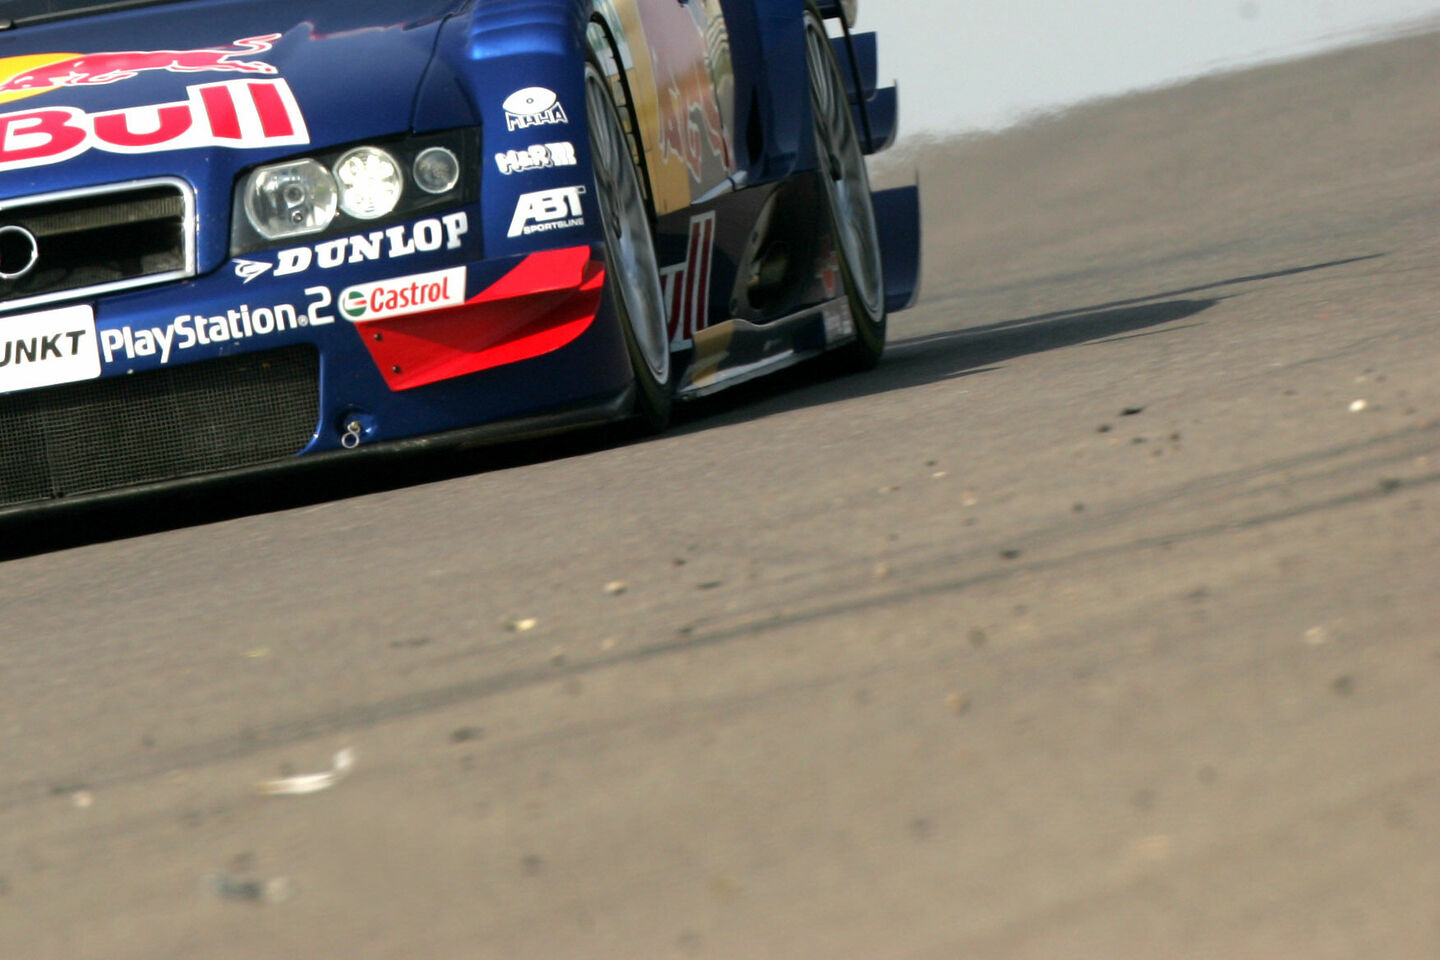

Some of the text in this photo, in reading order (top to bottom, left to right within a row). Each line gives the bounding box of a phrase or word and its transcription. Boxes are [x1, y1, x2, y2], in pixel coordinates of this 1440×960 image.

[507, 185, 586, 238] ABT
[273, 212, 469, 277] DUNLOP
[369, 276, 450, 313] Castrol
